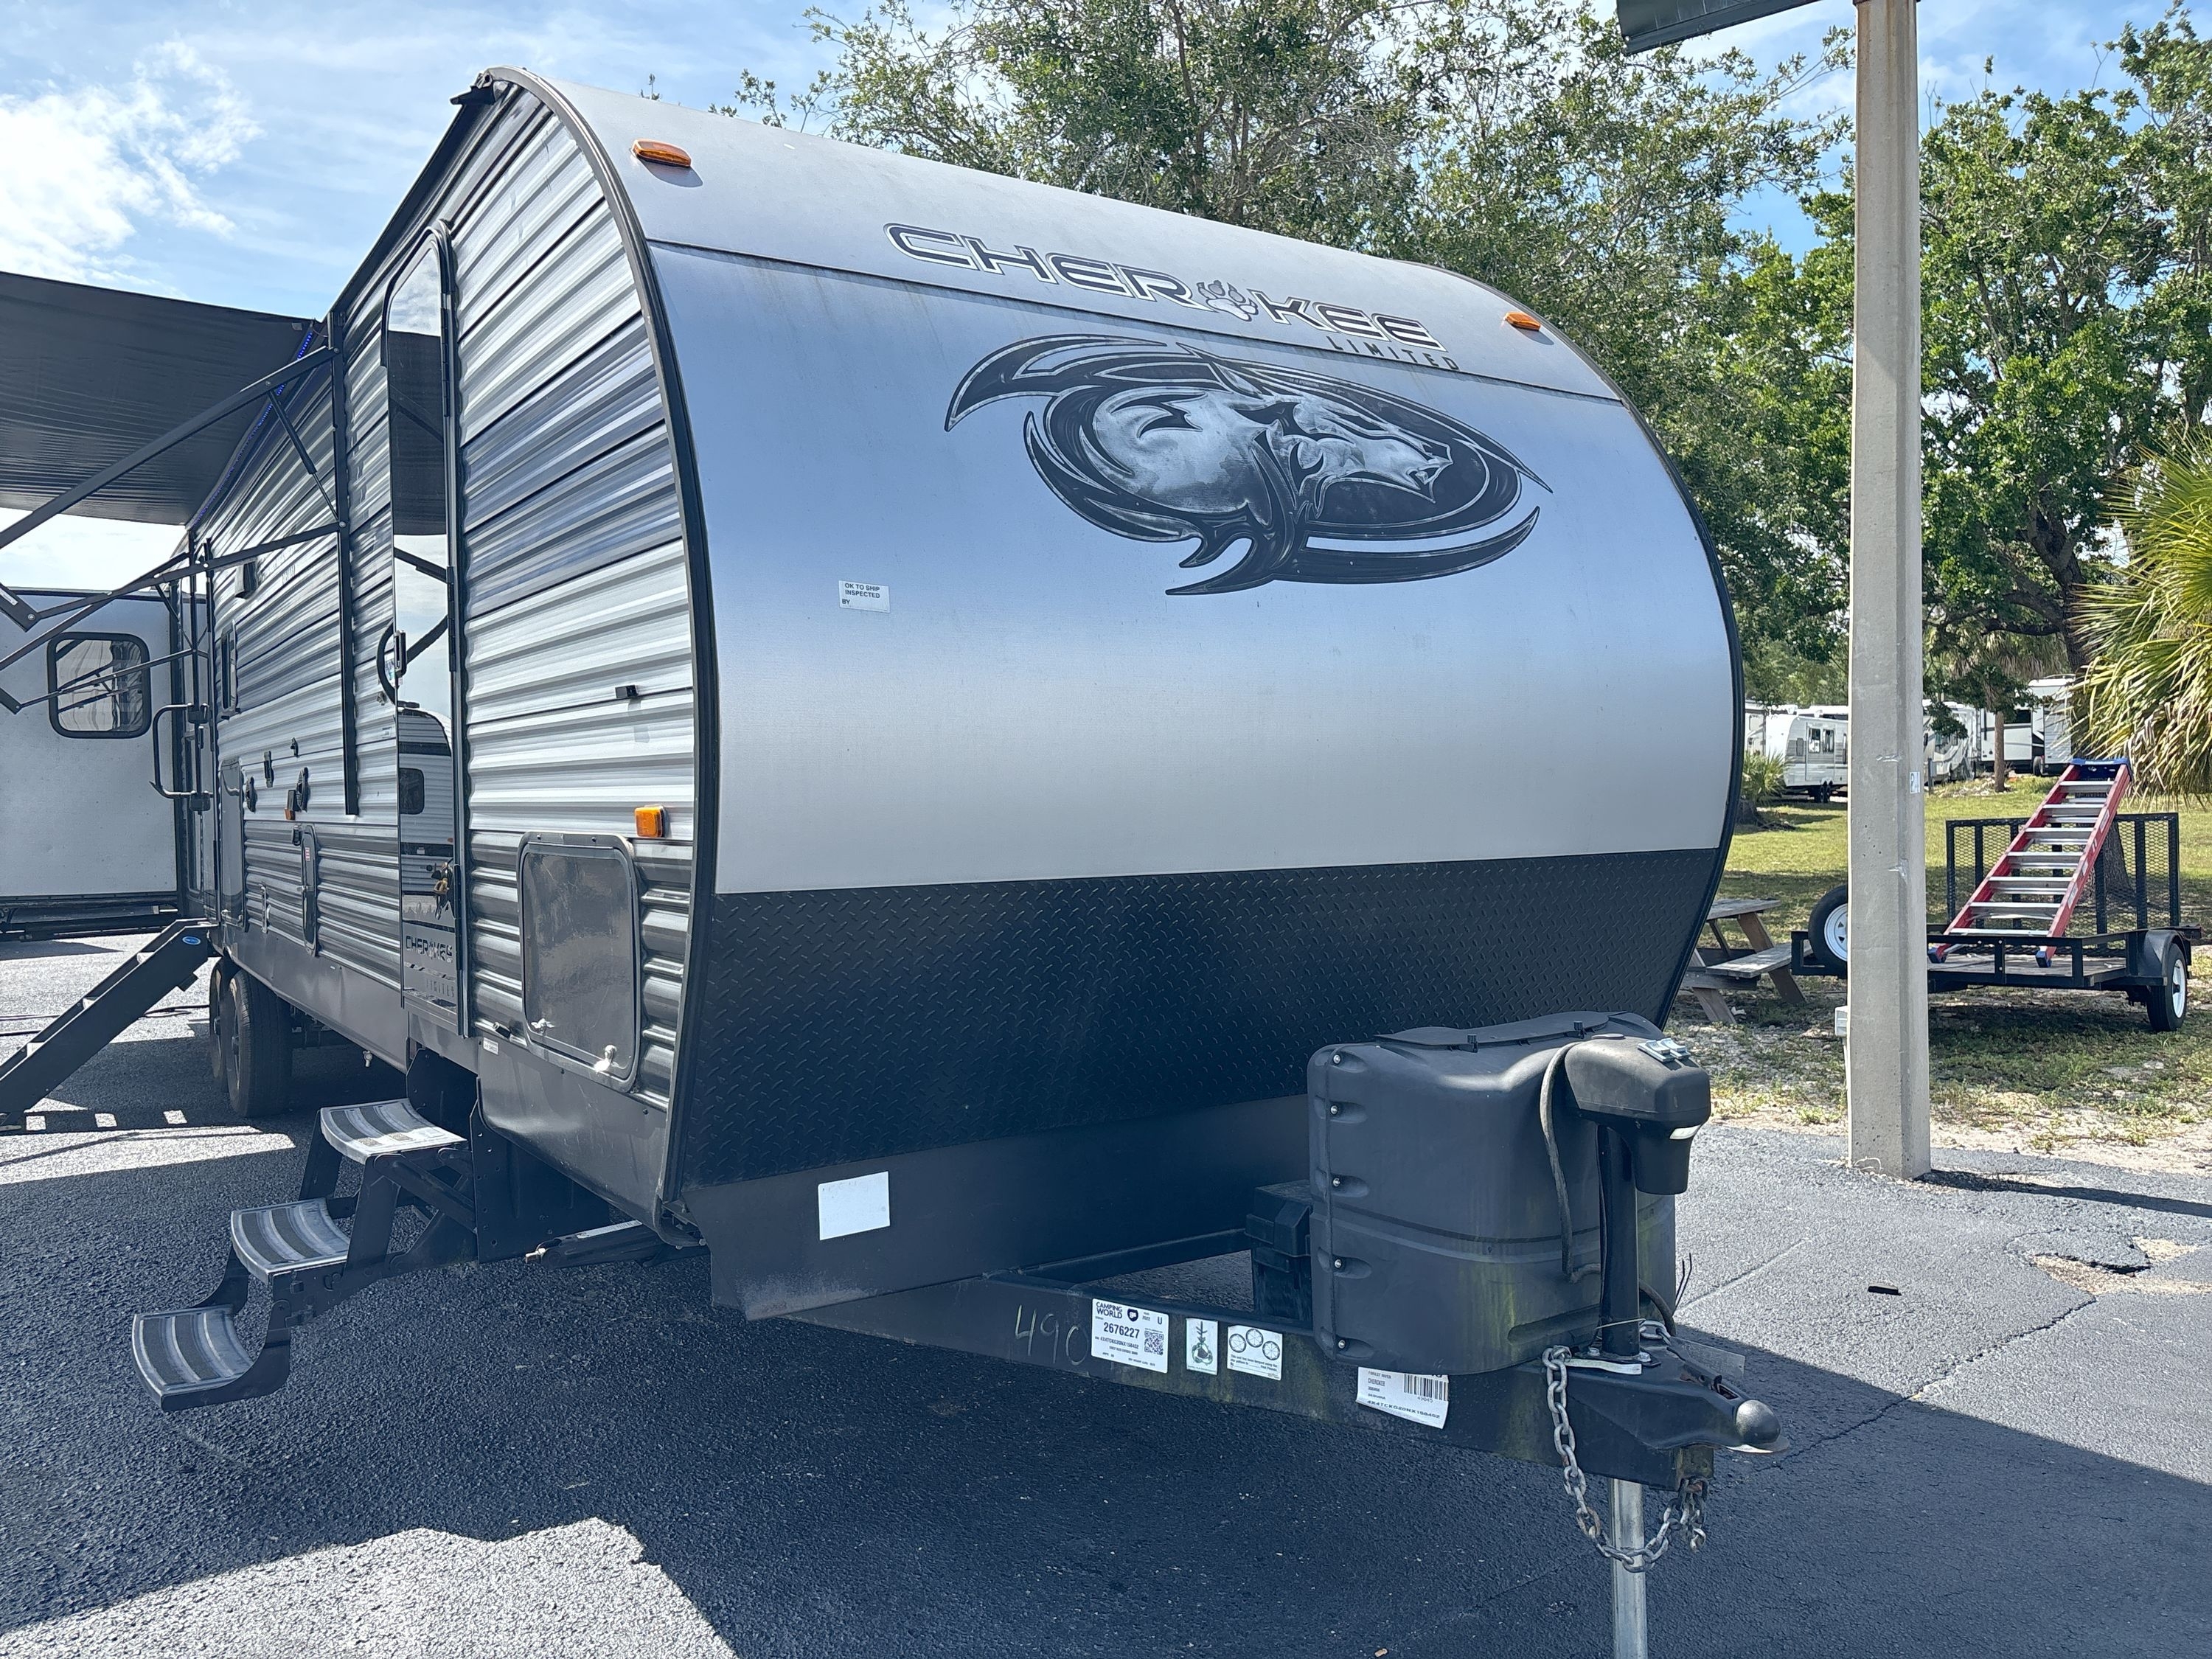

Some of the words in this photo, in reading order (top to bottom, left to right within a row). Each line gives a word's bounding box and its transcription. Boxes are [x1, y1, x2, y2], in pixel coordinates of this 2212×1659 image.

[1326, 335, 1460, 371] LIMITED
[845, 589, 880, 599] INSPECTED
[1096, 1301, 1123, 1312] CAMPING
[1096, 1307, 1123, 1319] WORLD
[1157, 1316, 1163, 1325] U
[1103, 1322, 1140, 1339] 2676227
